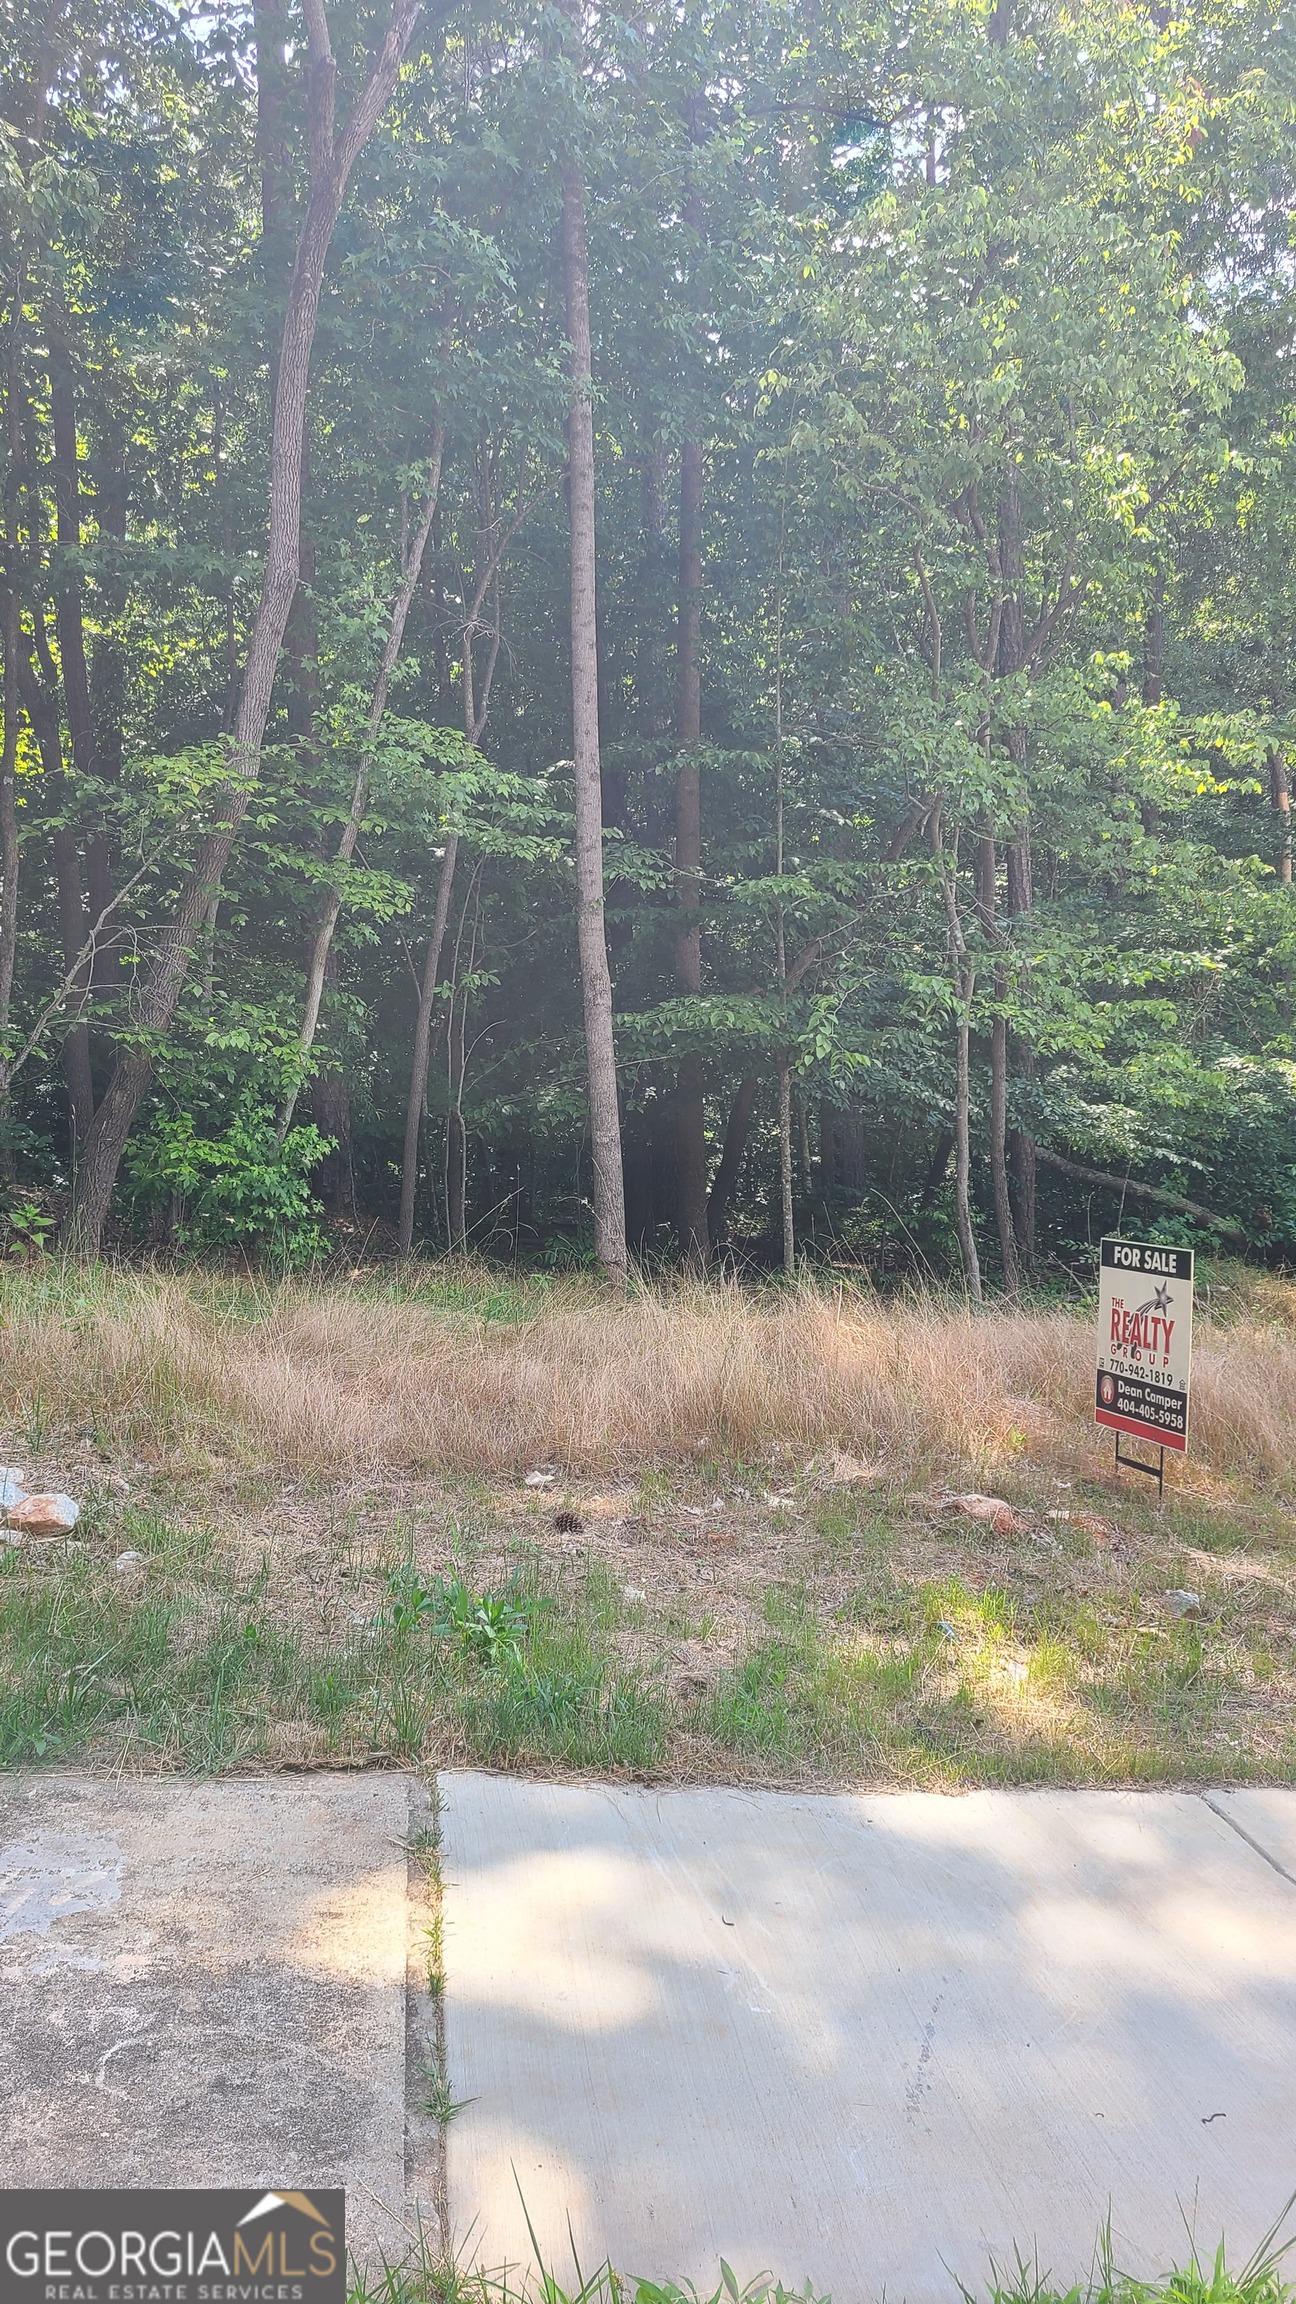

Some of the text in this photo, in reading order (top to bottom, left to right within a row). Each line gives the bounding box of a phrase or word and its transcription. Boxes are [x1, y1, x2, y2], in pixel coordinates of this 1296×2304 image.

[1113, 1246, 1177, 1273] FOR SALE
[1111, 1297, 1124, 1308] THE
[1110, 1308, 1175, 1354] REALTY
[1110, 1344, 1169, 1368] GROUP
[1109, 1359, 1173, 1386] 770-942-1819
[1117, 1381, 1182, 1410] Dean Camper
[1117, 1398, 1183, 1429] 404-405-5958
